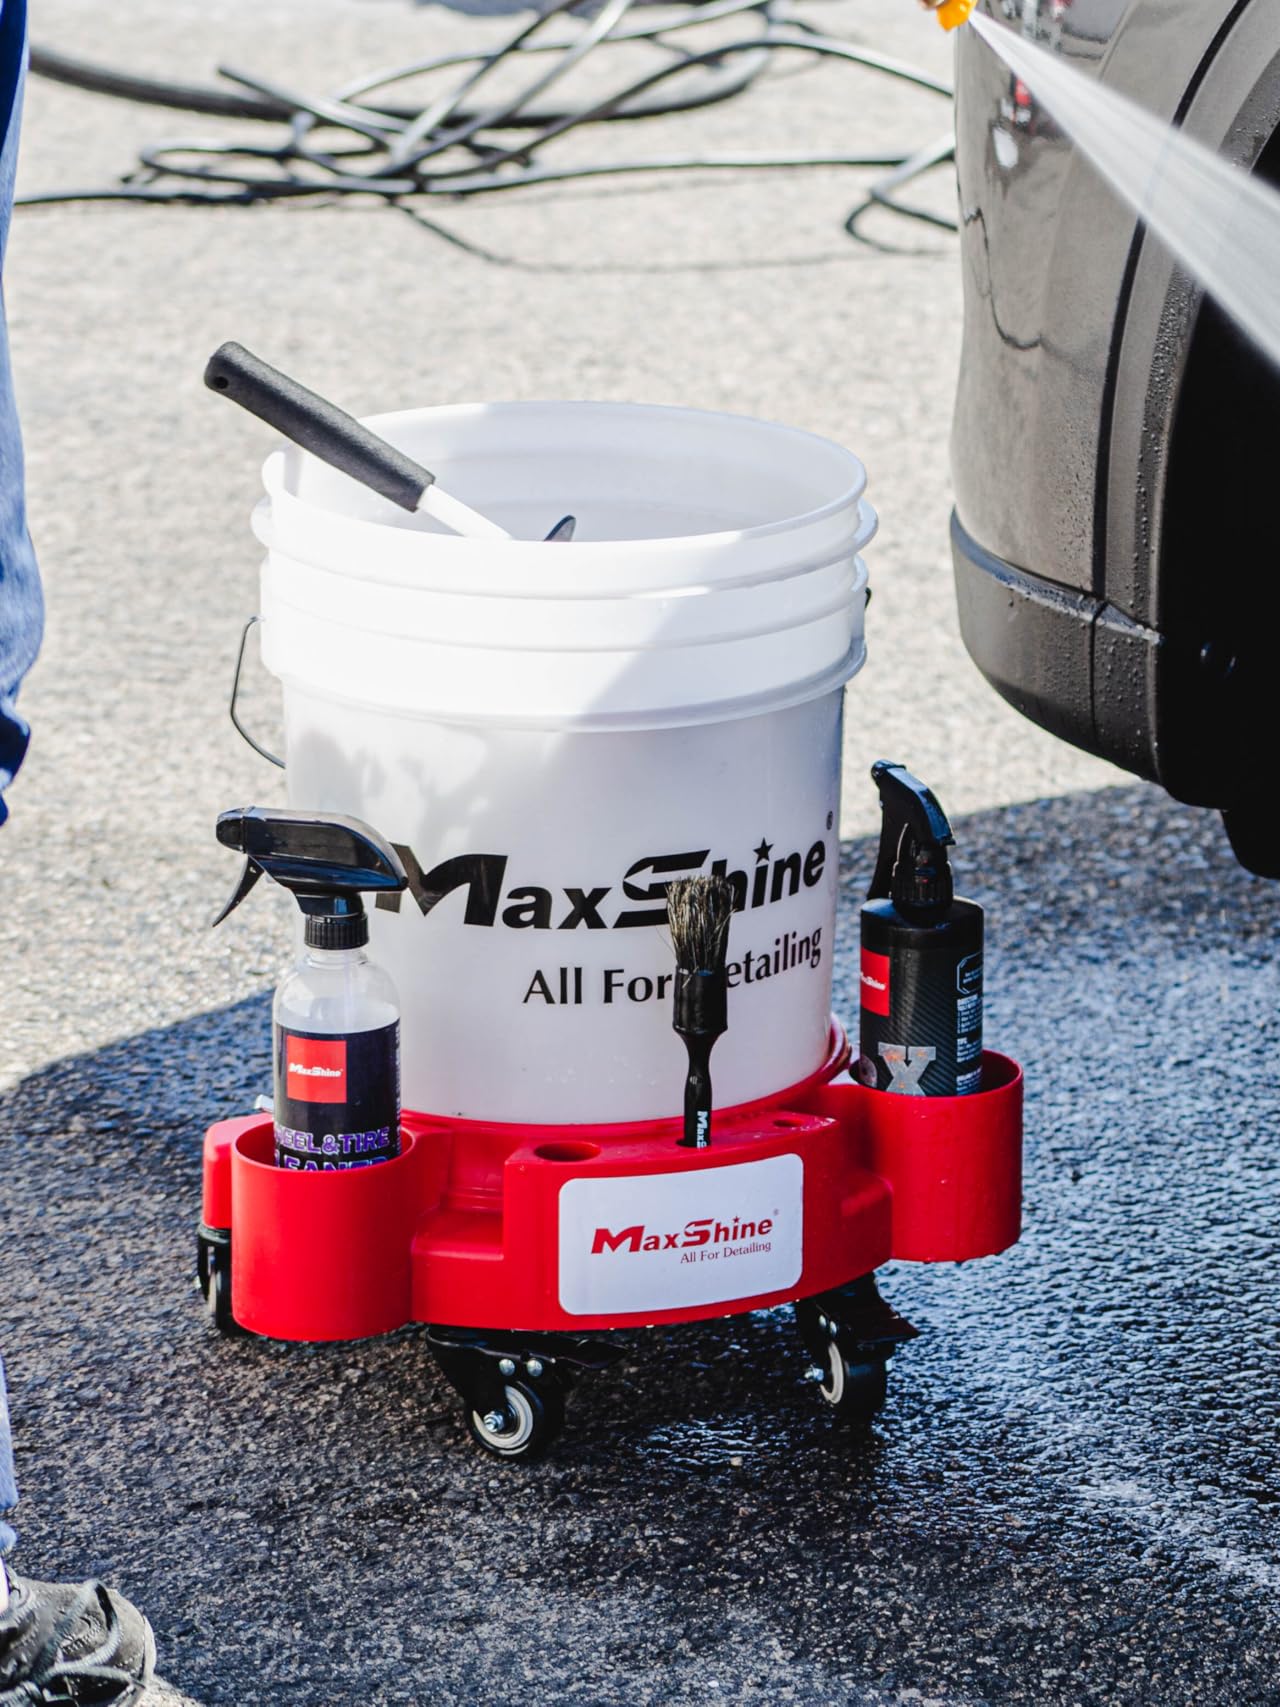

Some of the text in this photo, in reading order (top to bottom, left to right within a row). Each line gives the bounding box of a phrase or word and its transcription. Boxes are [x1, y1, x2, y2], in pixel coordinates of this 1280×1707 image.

[522, 927, 822, 1005] All For etailing
[680, 1241, 772, 1264] All For Detailing
